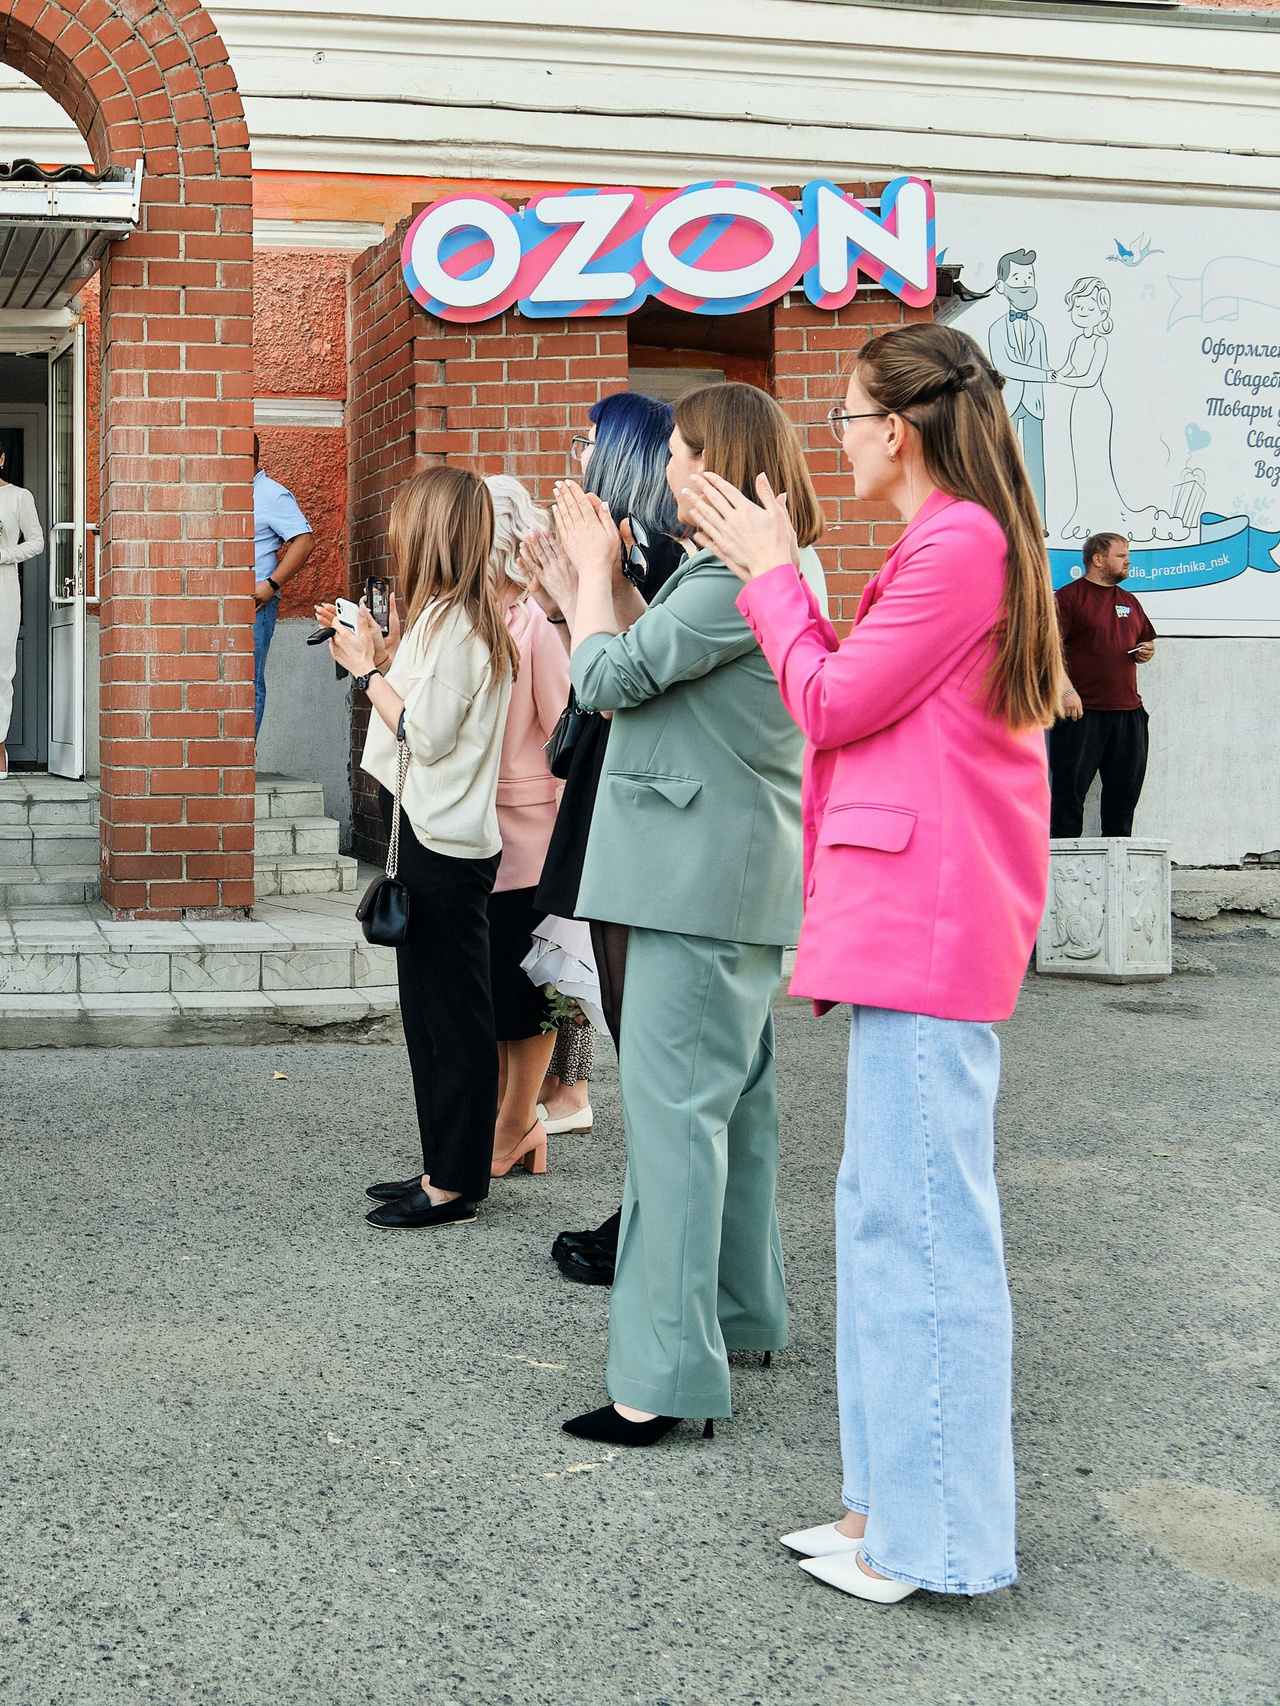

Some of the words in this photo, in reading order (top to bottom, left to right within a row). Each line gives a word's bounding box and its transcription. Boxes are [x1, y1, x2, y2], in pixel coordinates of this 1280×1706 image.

[411, 182, 928, 307] OZON
[1224, 368, 1280, 396] Свадеб
[1206, 397, 1273, 425] Товары
[1128, 553, 1230, 580] dia_prazdnika_nsk
